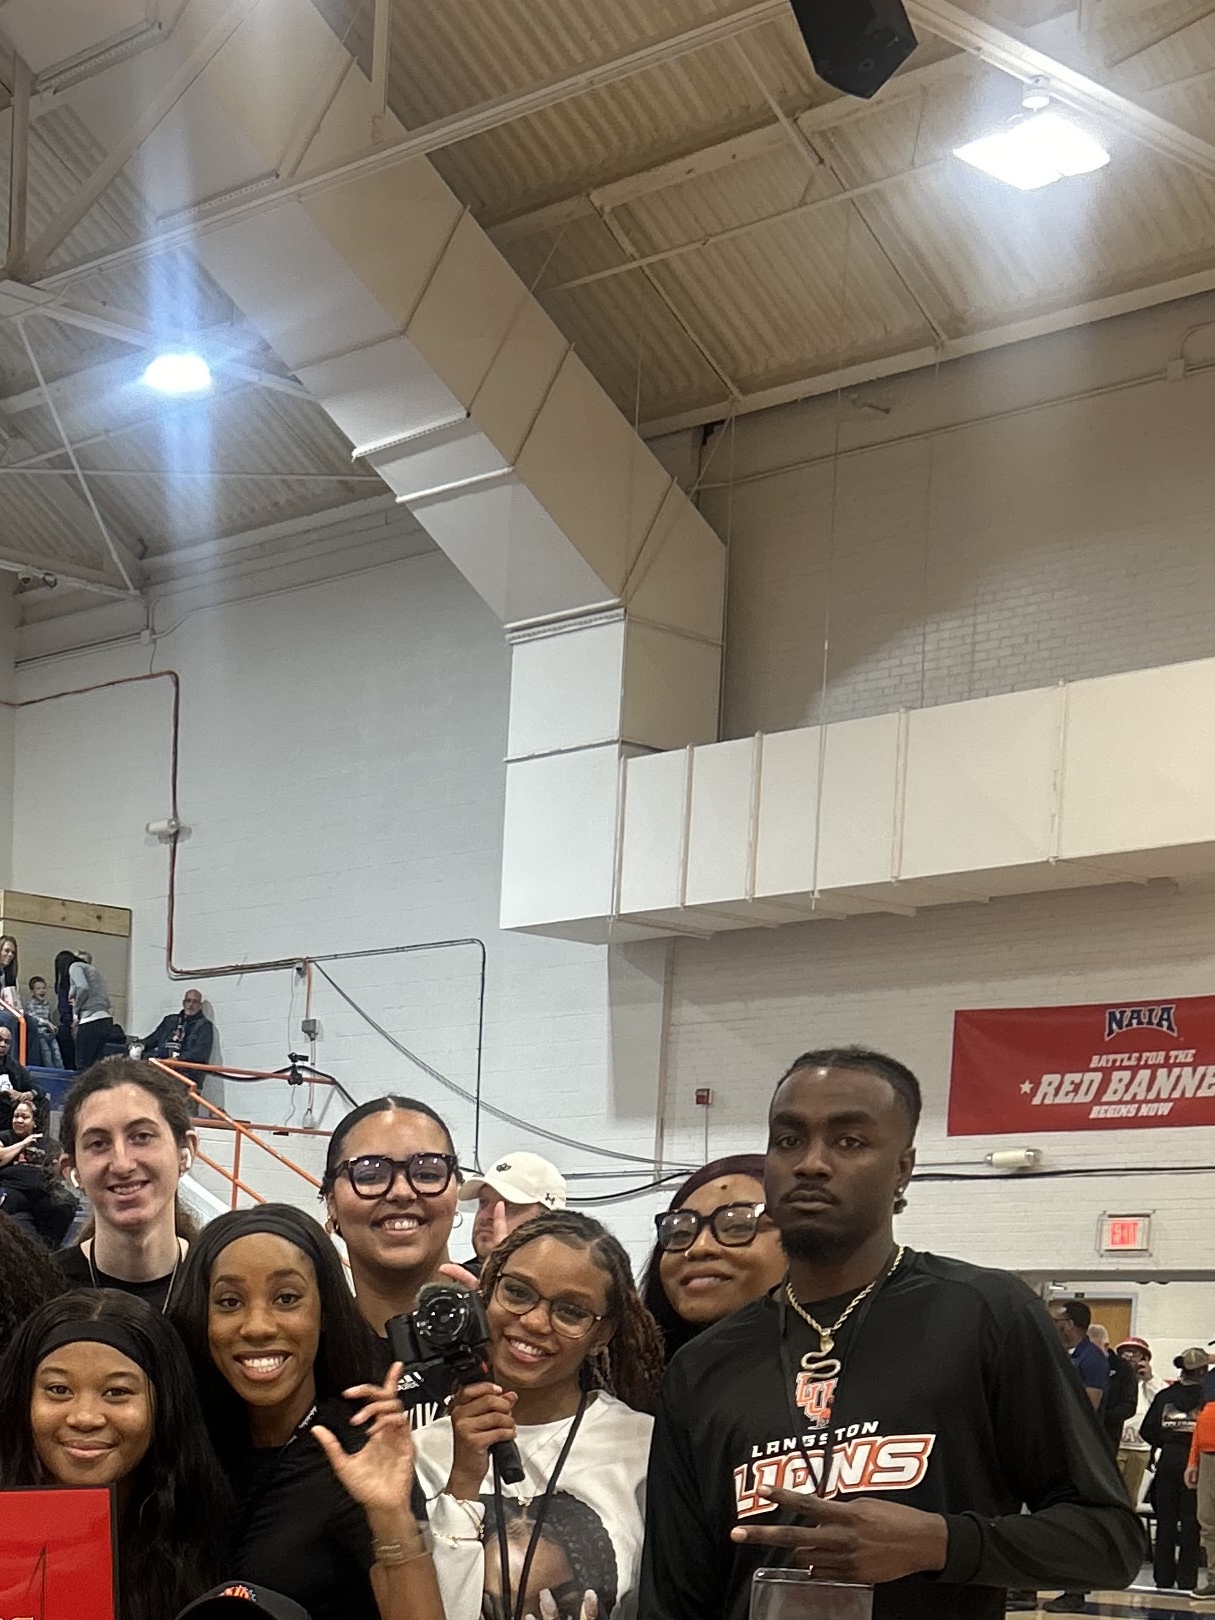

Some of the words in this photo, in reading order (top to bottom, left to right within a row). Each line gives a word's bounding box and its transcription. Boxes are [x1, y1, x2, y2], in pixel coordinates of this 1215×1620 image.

[1104, 1004, 1178, 1042] NAIA
[1089, 1053, 1140, 1068] BATTLE
[1139, 1051, 1166, 1066] FOR
[1168, 1049, 1196, 1064] THE
[1031, 1071, 1103, 1105] RED
[1089, 1103, 1140, 1118] BEGINS
[1138, 1102, 1174, 1117] NOW
[751, 1420, 879, 1458] LANGSTON
[734, 1434, 936, 1520] LIONS
